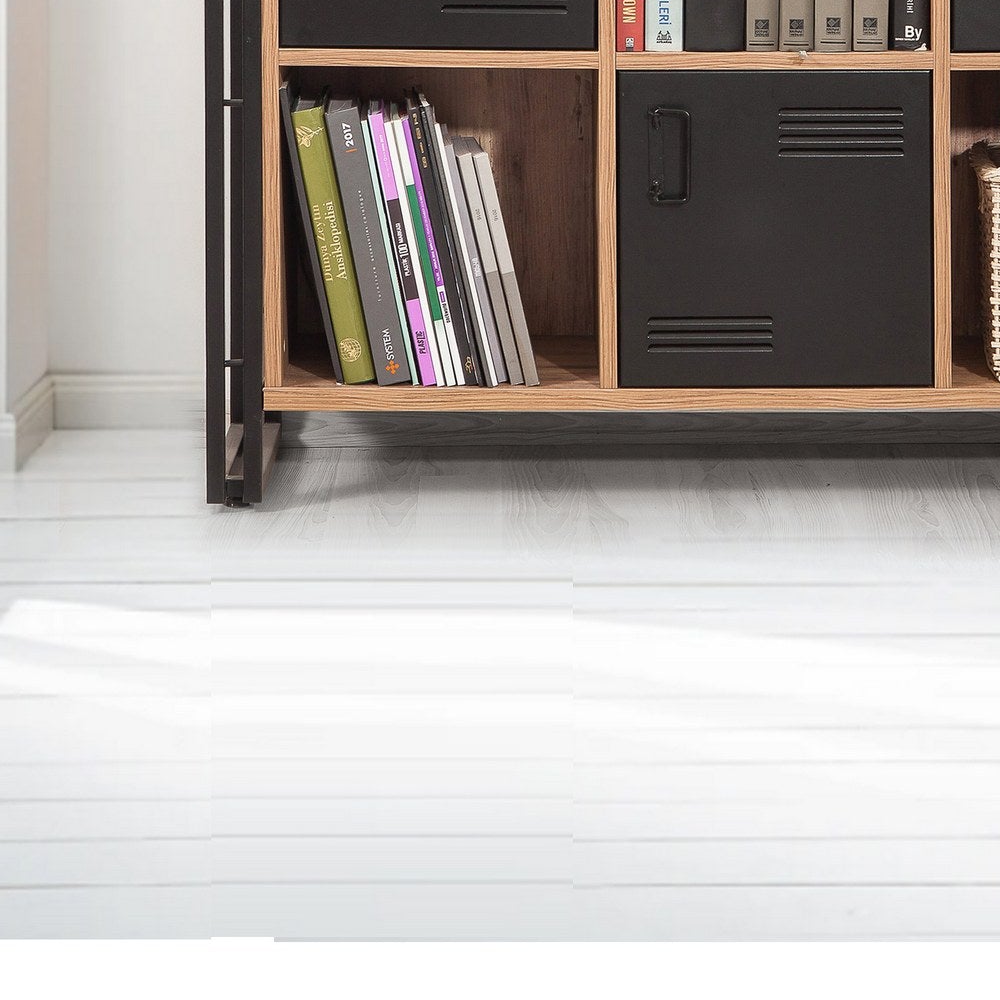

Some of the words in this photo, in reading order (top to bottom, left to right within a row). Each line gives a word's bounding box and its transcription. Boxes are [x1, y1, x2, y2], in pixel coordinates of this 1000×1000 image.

[905, 25, 923, 40] By
[341, 122, 354, 147] 2017
[322, 200, 348, 280] Ansiklopedisi
[398, 243, 409, 258] 100
[382, 328, 395, 360] SYSTEM
